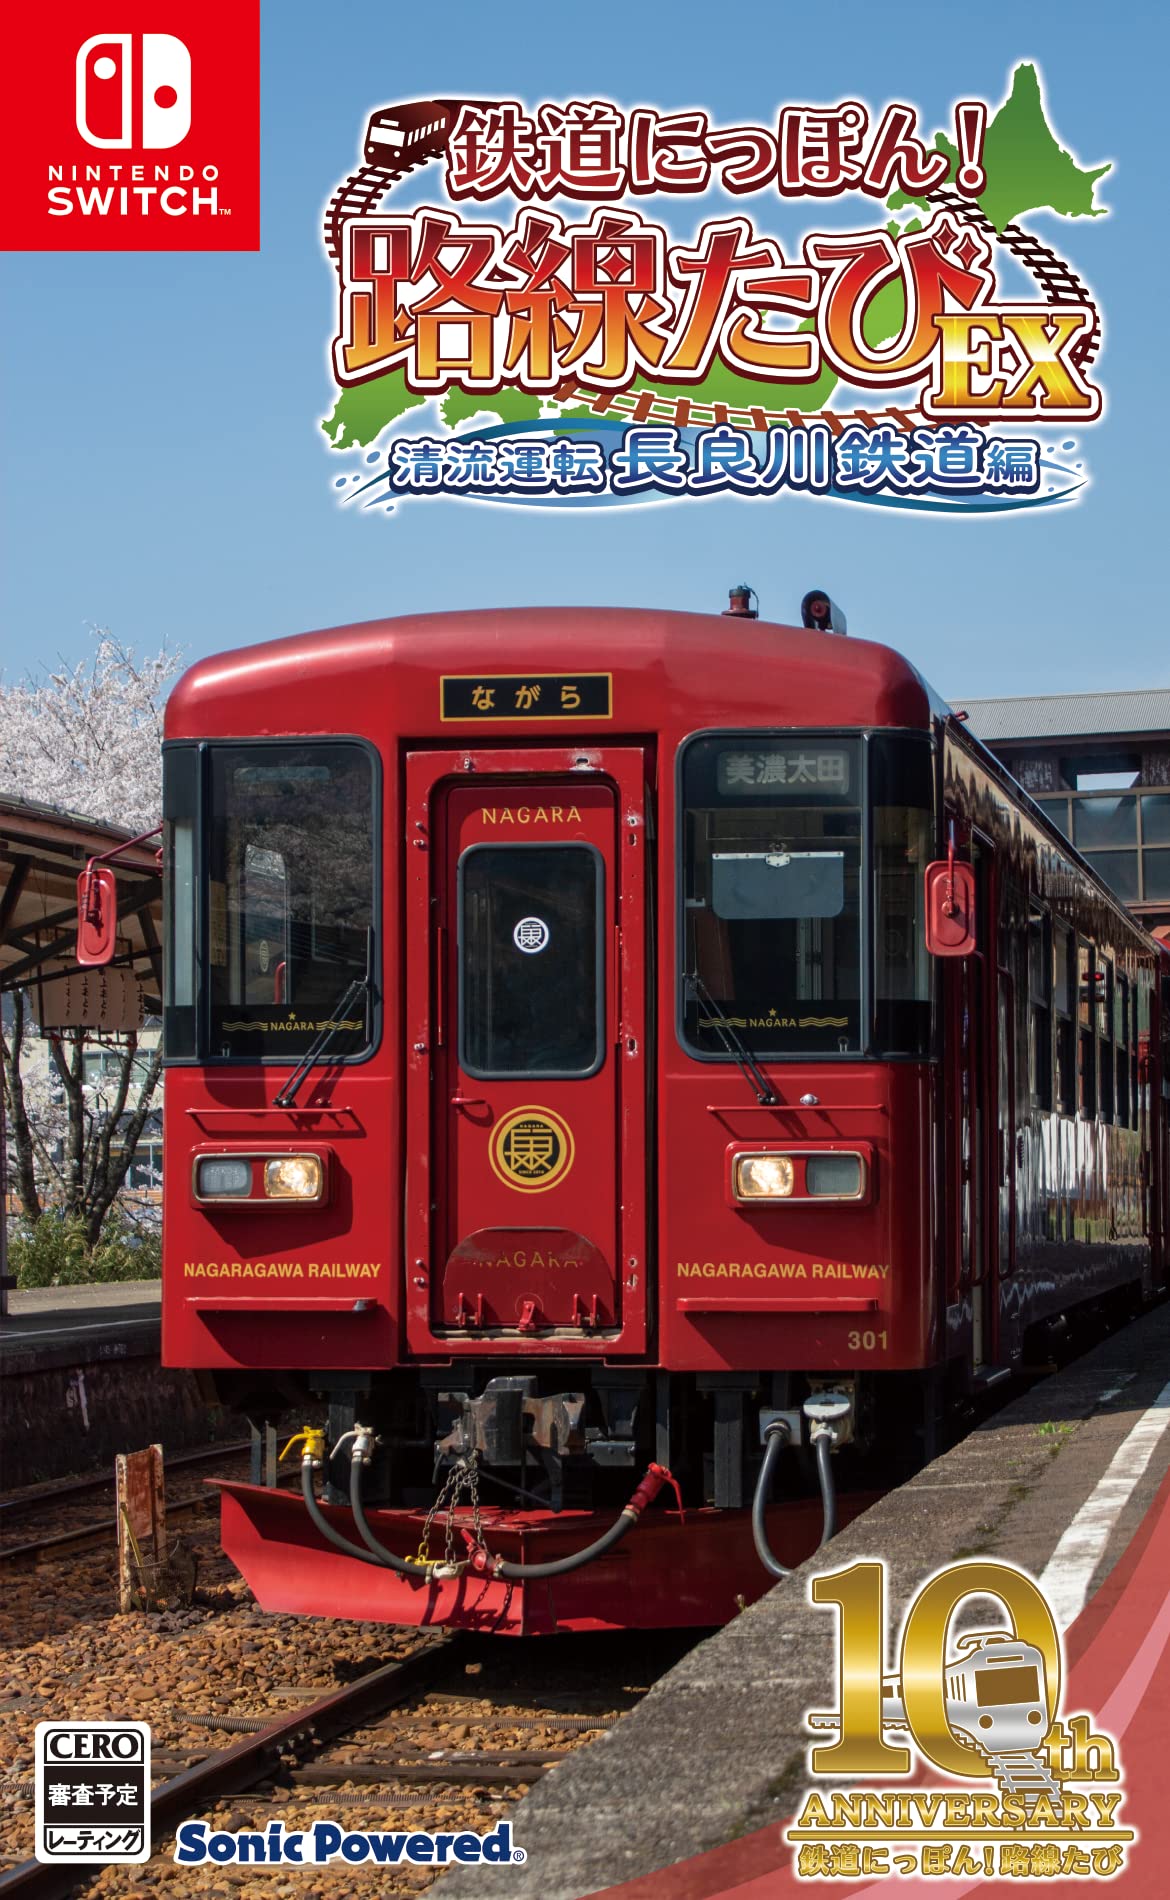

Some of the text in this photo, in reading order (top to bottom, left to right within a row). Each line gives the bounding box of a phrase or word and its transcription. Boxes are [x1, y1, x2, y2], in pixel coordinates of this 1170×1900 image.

[471, 684, 582, 711] ながら
[726, 754, 845, 785] 美濃太田
[481, 805, 582, 825] NAGARA
[270, 1021, 315, 1031] NAGARA
[749, 1018, 797, 1028] NAGARA
[183, 1262, 382, 1279] NAGARAGAWA RAILWAY
[676, 1262, 890, 1279] NAGARAGAWA RAILWAY
[847, 1330, 888, 1350] 301
